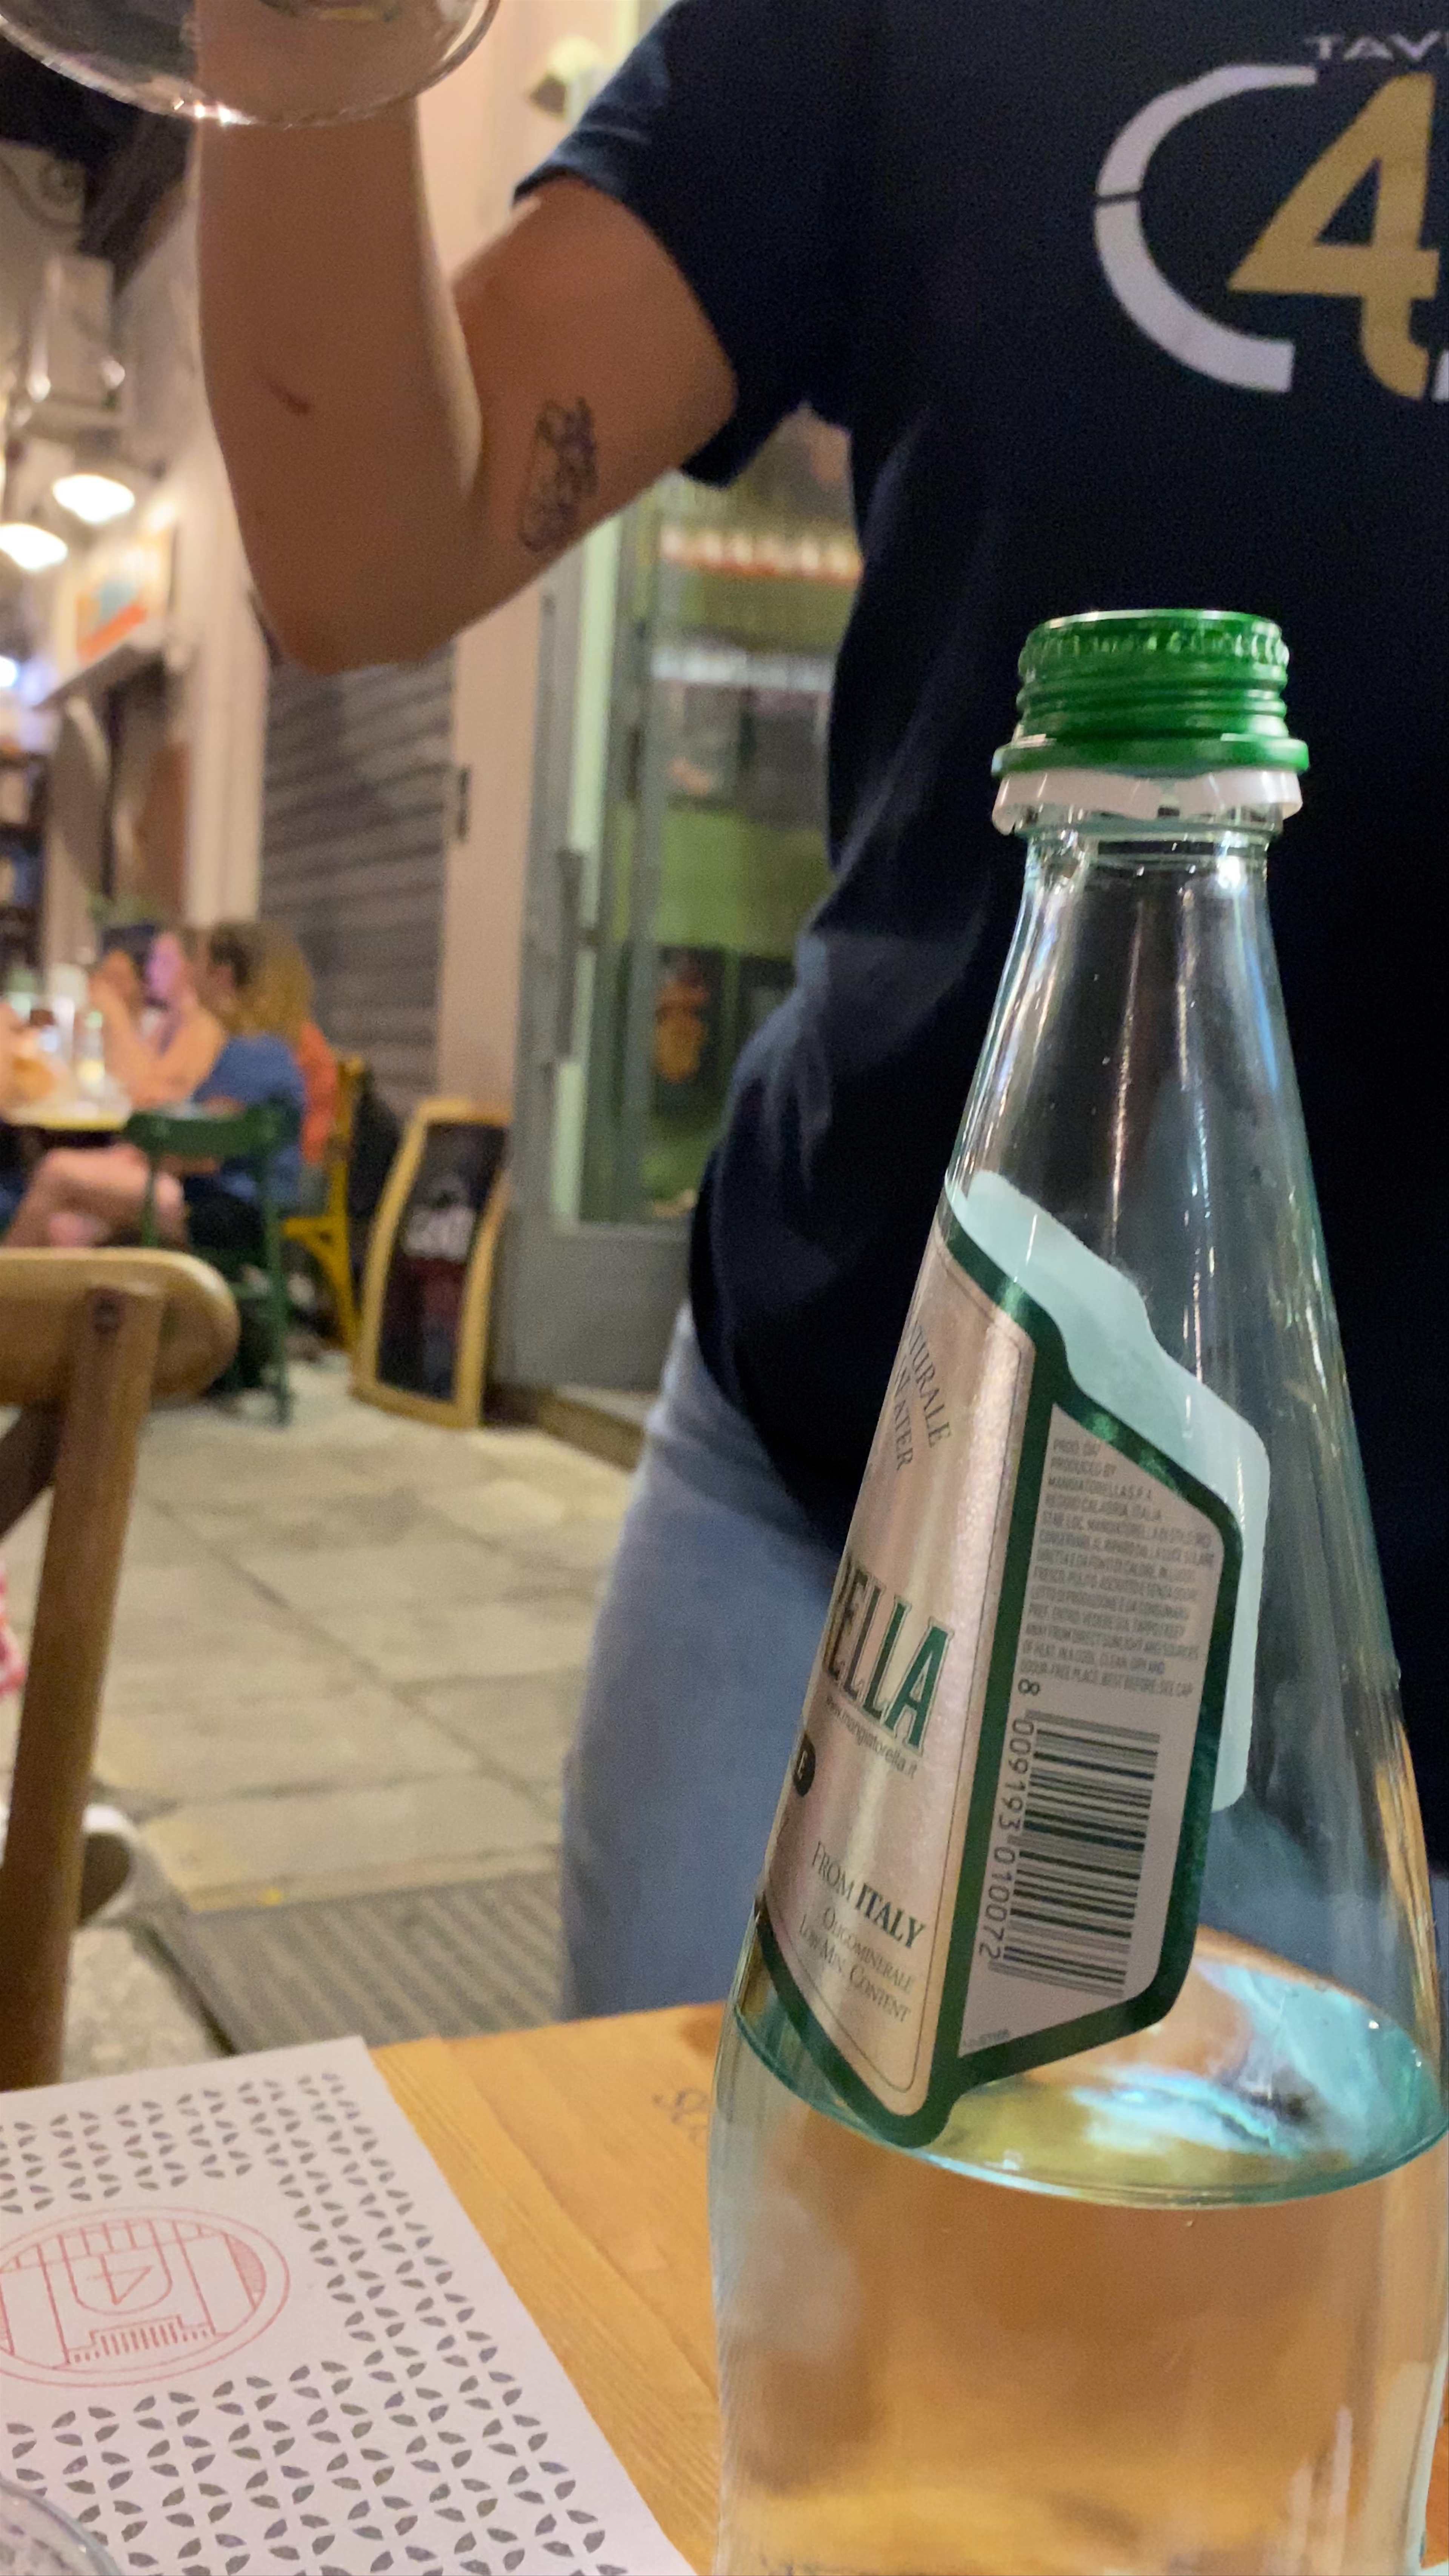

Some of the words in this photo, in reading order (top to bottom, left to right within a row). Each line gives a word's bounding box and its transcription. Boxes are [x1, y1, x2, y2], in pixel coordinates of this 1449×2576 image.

[1301, 30, 1449, 61] TAV
[823, 1559, 955, 1757] ELLA
[997, 1717, 1034, 1831] 009193
[812, 1840, 854, 1901] FROM
[855, 1882, 926, 1949] ITALY
[979, 1847, 1015, 1960] 010072
